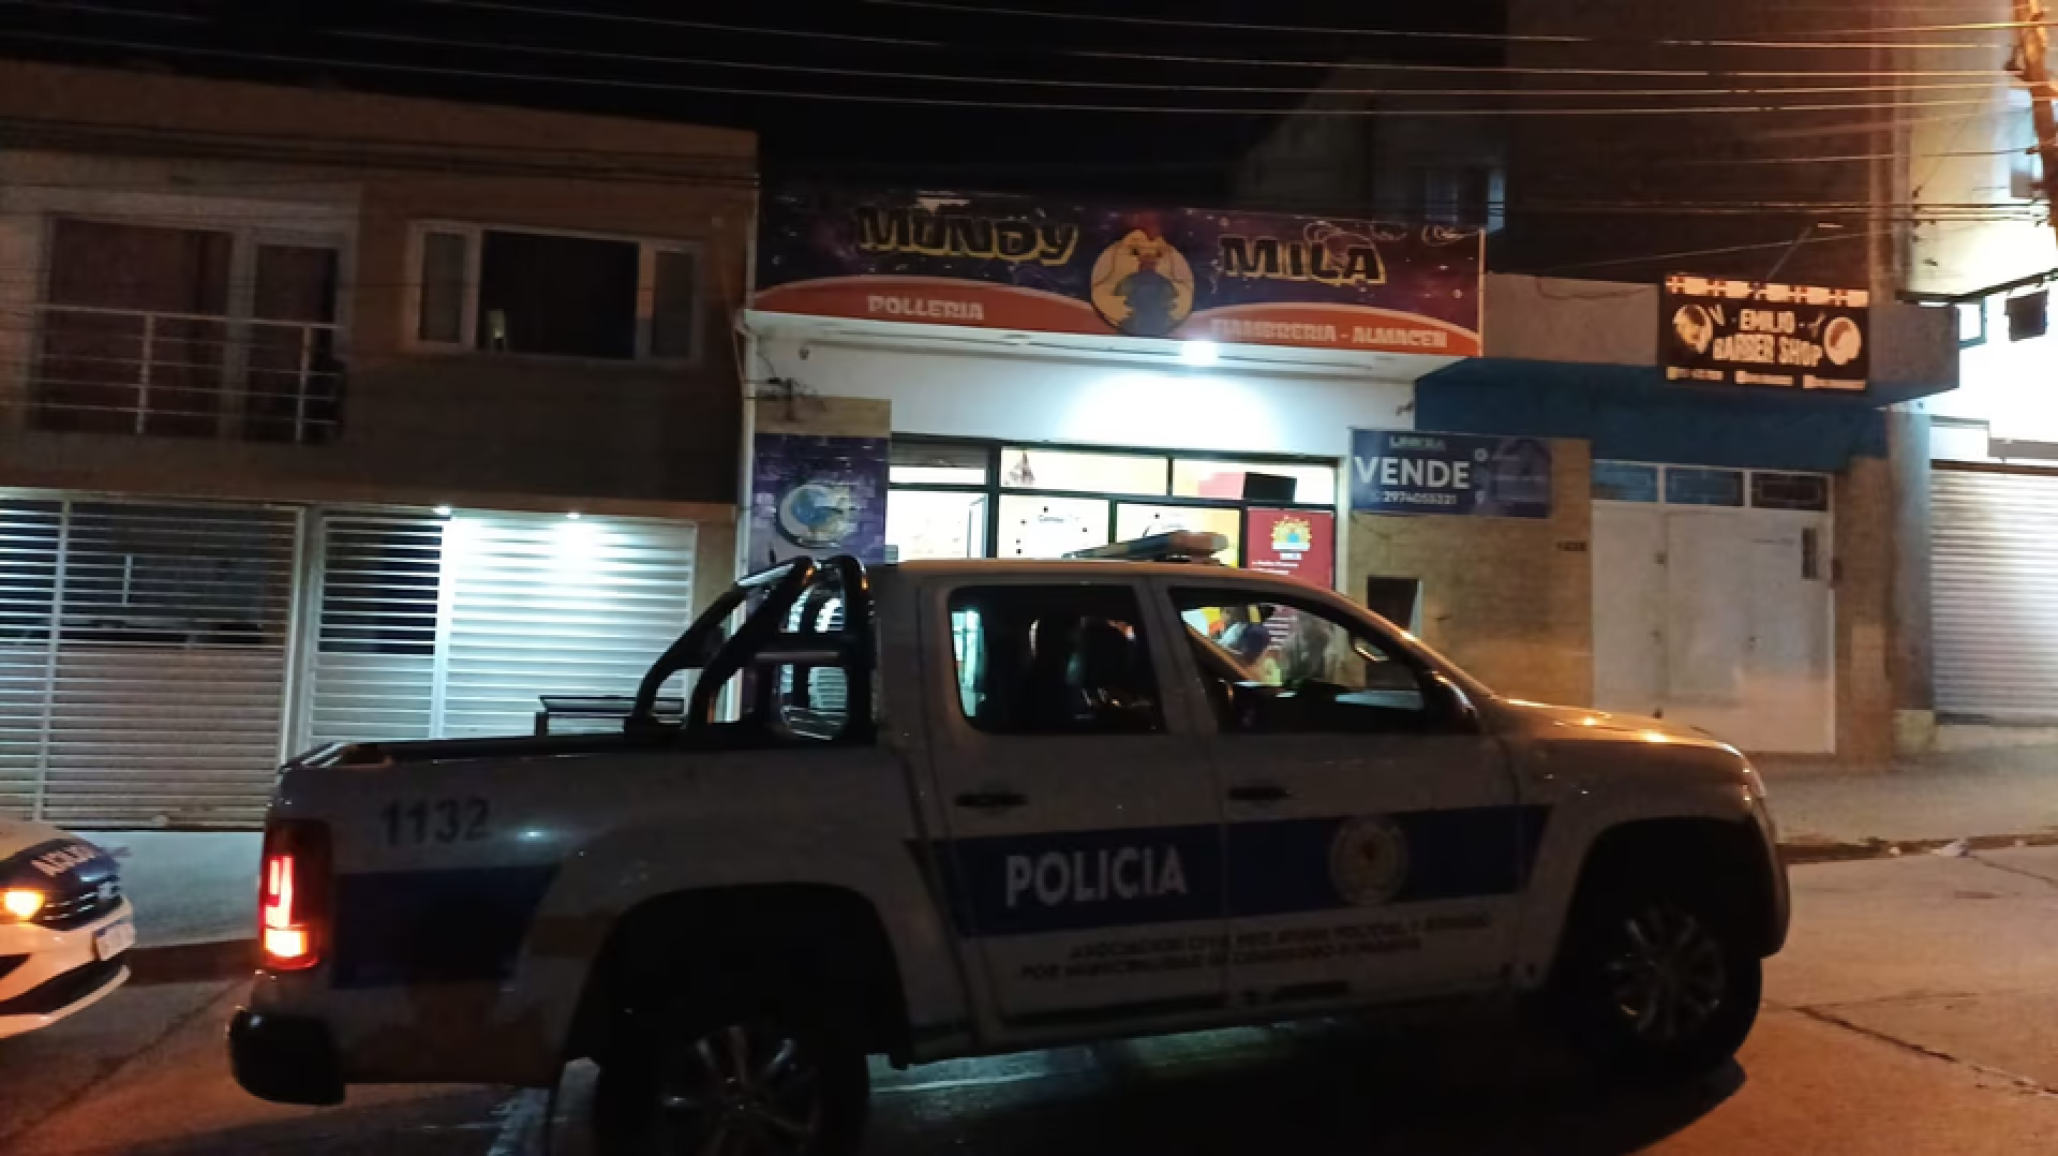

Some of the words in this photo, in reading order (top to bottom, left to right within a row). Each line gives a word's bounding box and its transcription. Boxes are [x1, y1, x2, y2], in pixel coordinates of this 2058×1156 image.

[1216, 235, 1386, 286] MILA
[866, 295, 986, 321] POLLERIA
[1738, 308, 1796, 334] EMILIO
[1352, 325, 1448, 348] ALMACEN
[1712, 332, 1776, 364] BARBER
[1778, 335, 1824, 368] SHOP
[1353, 455, 1471, 490] VENDE
[379, 797, 493, 847] 1132
[1004, 845, 1190, 910] POLICIA
